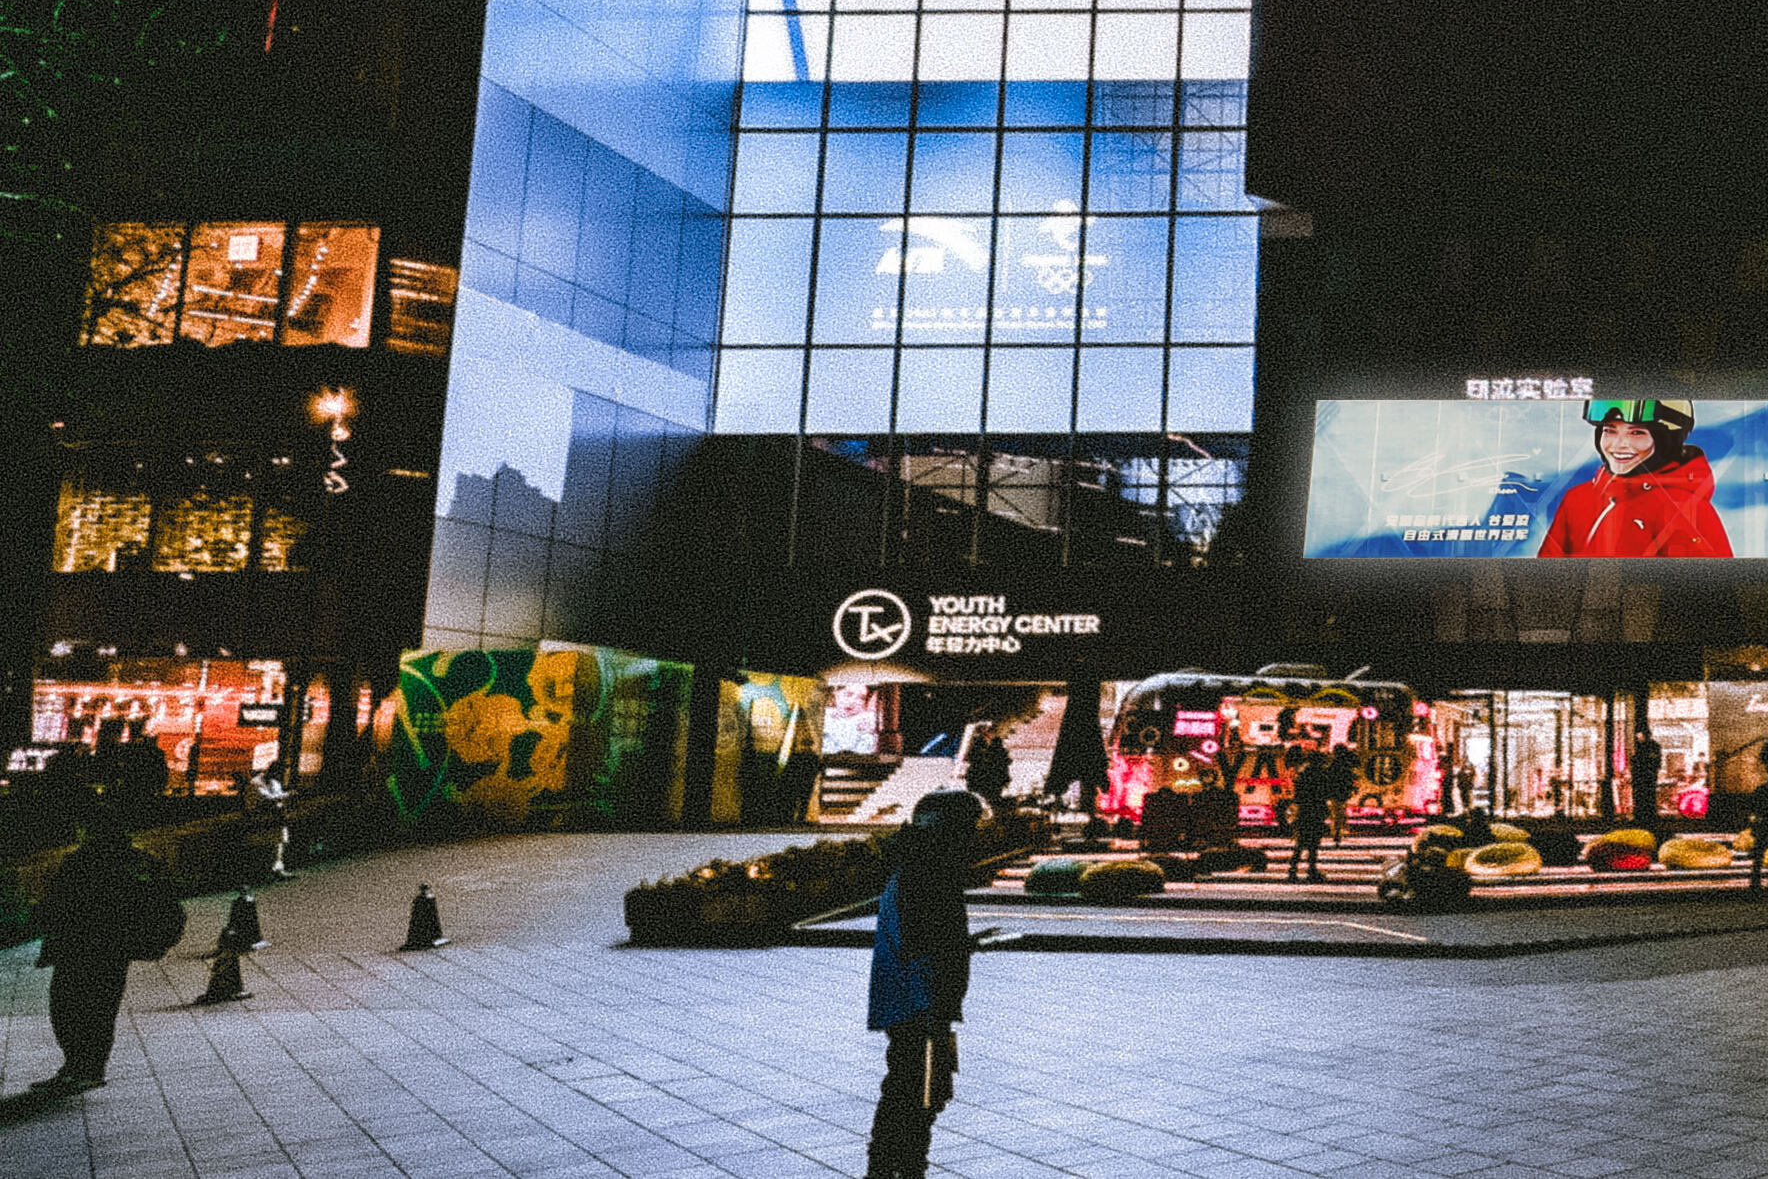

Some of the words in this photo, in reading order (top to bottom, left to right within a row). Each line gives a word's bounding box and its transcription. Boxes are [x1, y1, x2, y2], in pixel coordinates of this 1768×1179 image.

[928, 595, 1006, 614] YOUTH
[928, 615, 1012, 634] ENERGY
[1014, 614, 1101, 634] CENTER
